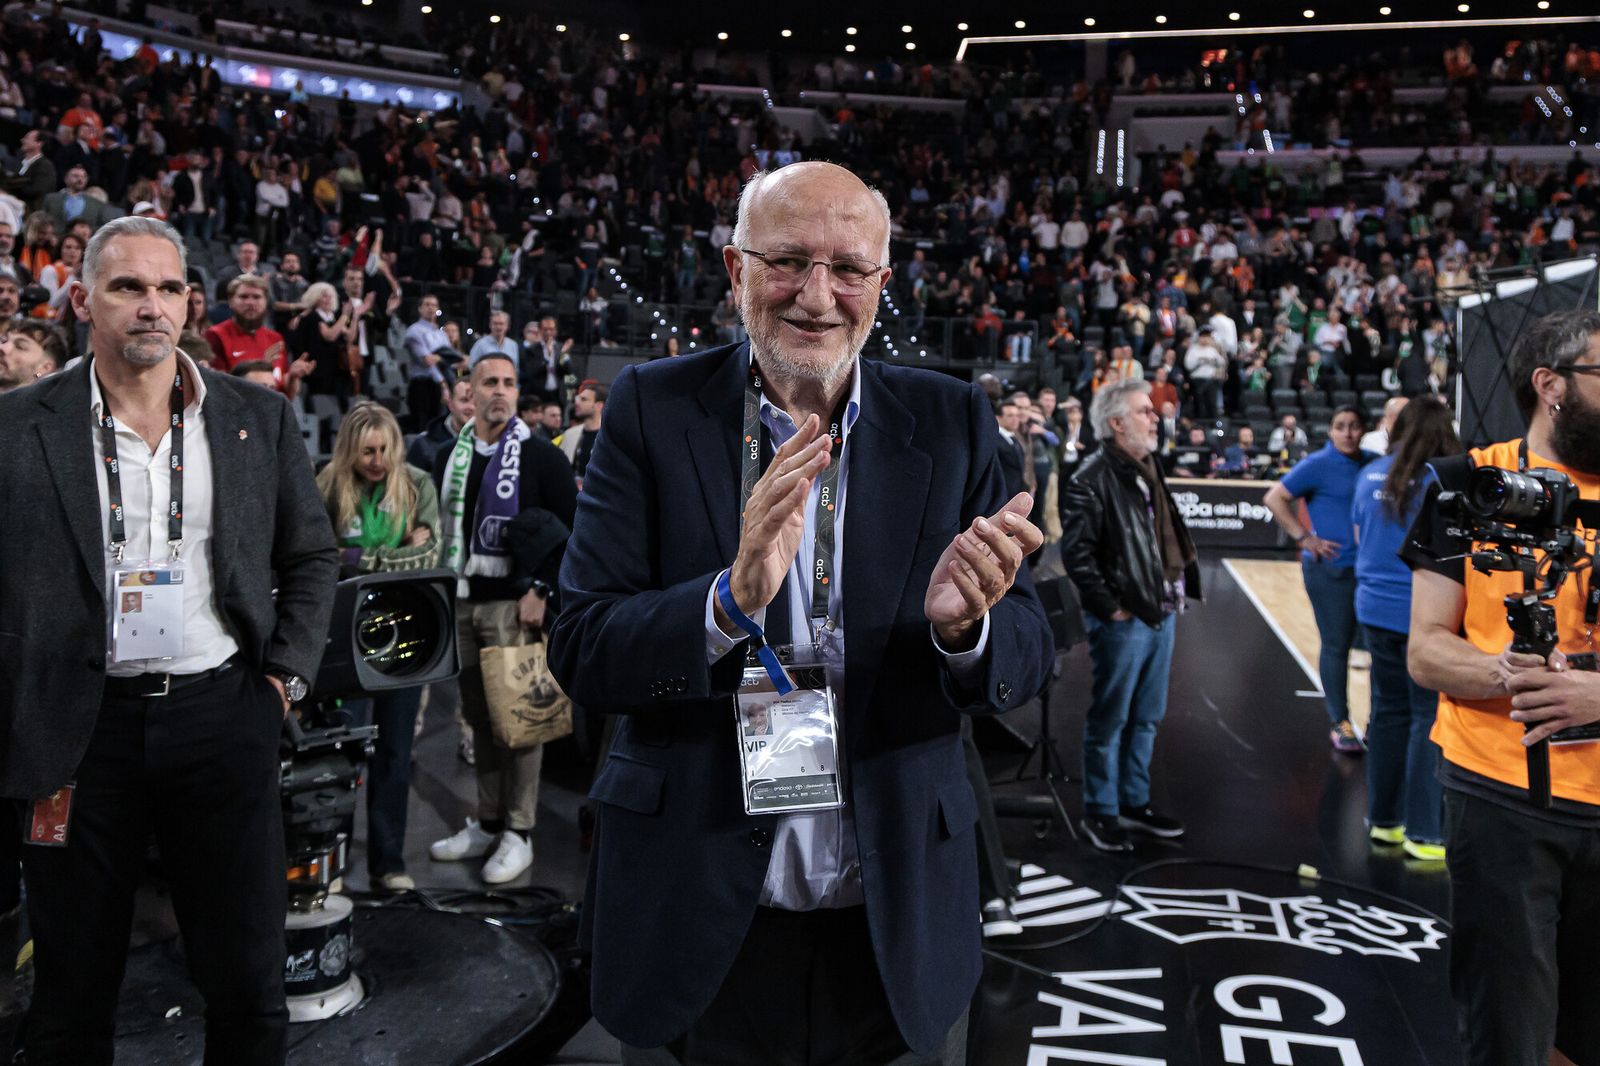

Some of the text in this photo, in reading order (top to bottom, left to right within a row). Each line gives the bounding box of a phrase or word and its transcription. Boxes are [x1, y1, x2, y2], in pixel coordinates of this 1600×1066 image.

[750, 439, 758, 460] acb
[821, 486, 830, 507] acb
[1238, 501, 1273, 523] Rey
[815, 558, 824, 580] acb
[745, 740, 767, 753] VIP
[800, 765, 806, 773] 6
[820, 764, 825, 772] 8
[52, 823, 66, 842] AA
